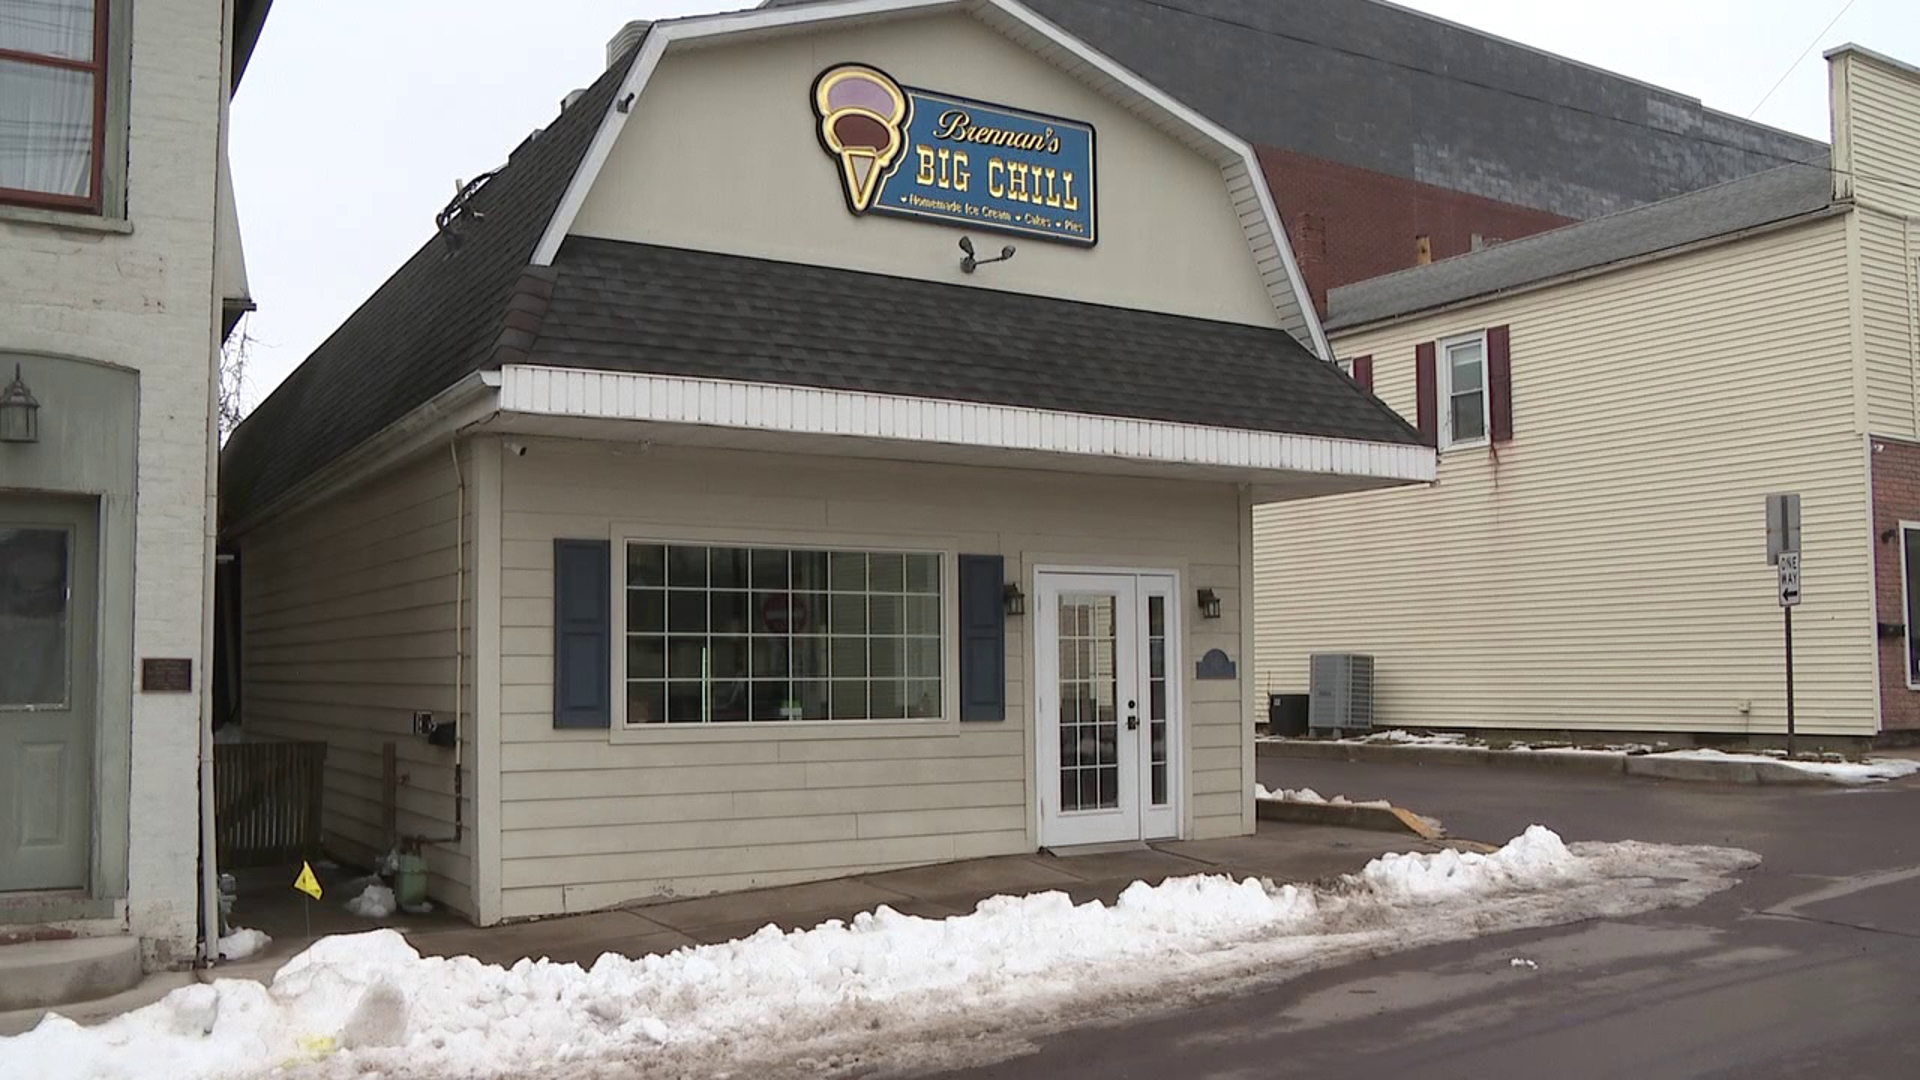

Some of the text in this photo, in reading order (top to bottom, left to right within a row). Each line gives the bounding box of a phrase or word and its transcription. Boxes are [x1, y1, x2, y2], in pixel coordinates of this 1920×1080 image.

[933, 109, 1060, 153] Brennan's
[915, 144, 1078, 211] BIG CHILL
[909, 193, 1084, 233] Homemade Ice Cream Cakes Pies
[1781, 556, 1797, 571] ONE
[1781, 572, 1797, 585] WAY
